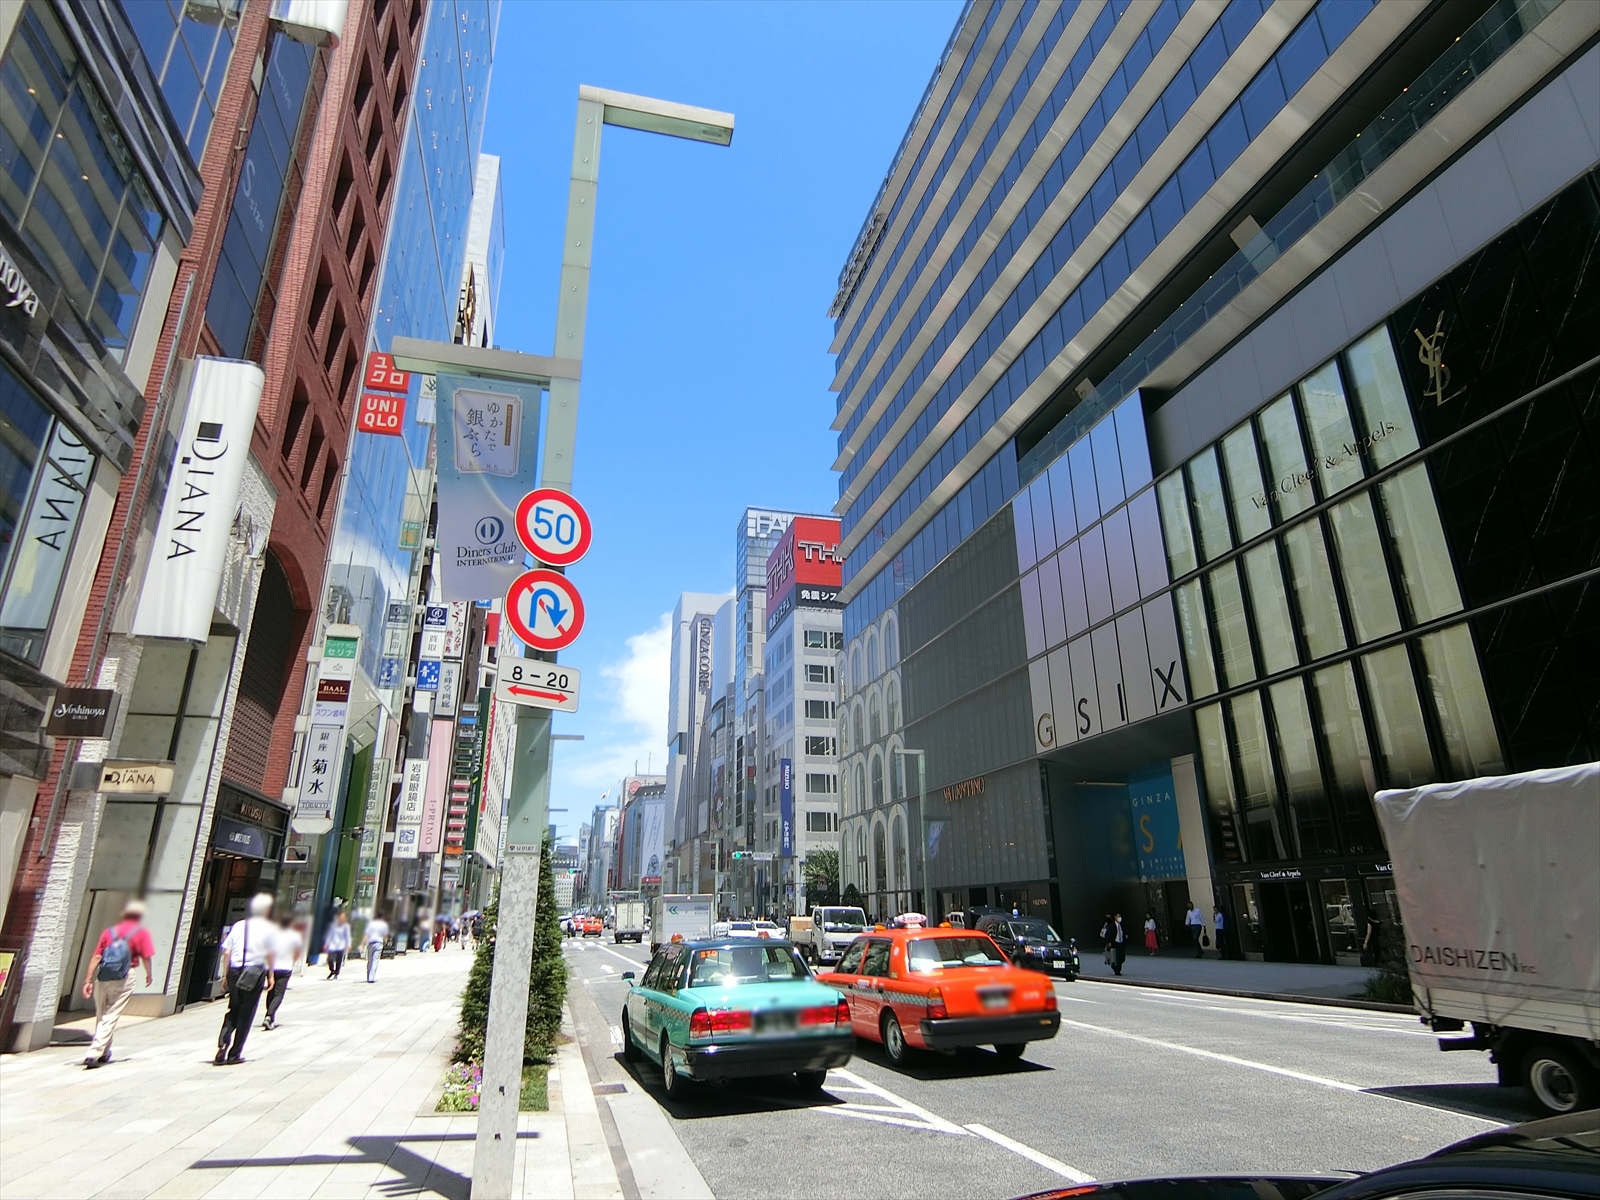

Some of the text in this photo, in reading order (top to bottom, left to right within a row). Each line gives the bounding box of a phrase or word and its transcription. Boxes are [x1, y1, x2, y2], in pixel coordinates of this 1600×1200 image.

[371, 371, 404, 386] クロ
[366, 397, 398, 413] UNI
[363, 414, 398, 428] QLO
[484, 402, 503, 452] ゆかたで
[463, 408, 484, 458] 銀ぶら
[1280, 458, 1321, 493] Cleef
[1341, 420, 1396, 456] Arpels
[533, 506, 576, 546] 50
[756, 512, 791, 538] FA
[456, 541, 517, 558] Diners Club
[766, 534, 795, 601] THK
[327, 648, 355, 657] セリナ
[323, 685, 346, 693] BAAL
[54, 703, 106, 718] Yoshinoya
[1132, 791, 1171, 807] GINZA
[424, 799, 437, 845] I-PRIMO
[1410, 944, 1519, 973] DAISHIZEN
